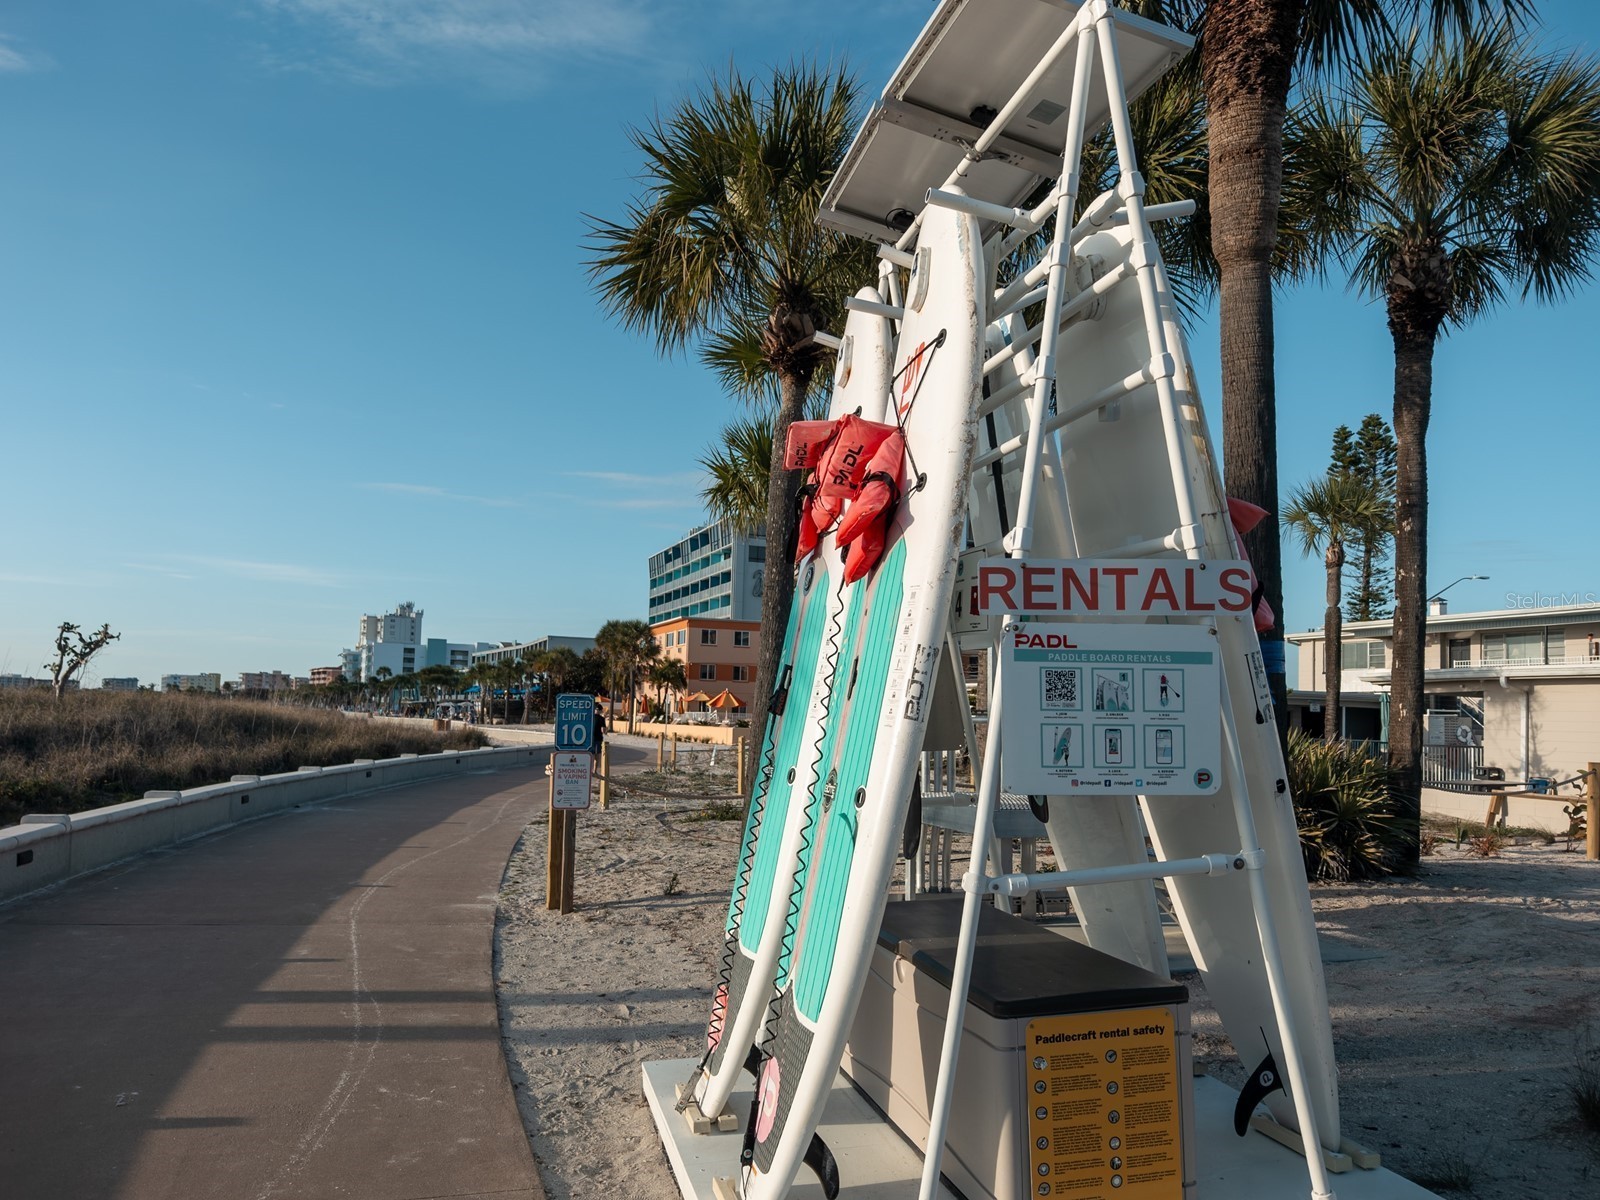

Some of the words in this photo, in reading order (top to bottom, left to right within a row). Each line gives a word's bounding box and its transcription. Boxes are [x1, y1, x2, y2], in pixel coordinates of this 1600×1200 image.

[795, 443, 808, 466] PADL
[832, 445, 864, 485] PADL
[980, 567, 1251, 611] RENTALS
[1014, 633, 1077, 649] PADL
[1048, 653, 1087, 661] PADDLE
[1090, 653, 1125, 662] BOARD
[1127, 654, 1172, 663] RENTALS
[560, 700, 591, 709] SPEED
[562, 712, 587, 720] LIMIT
[562, 724, 586, 745] 10
[1035, 1030, 1096, 1044] Paddlecraft
[1100, 1027, 1130, 1039] rental
[1133, 1024, 1165, 1036] safety
